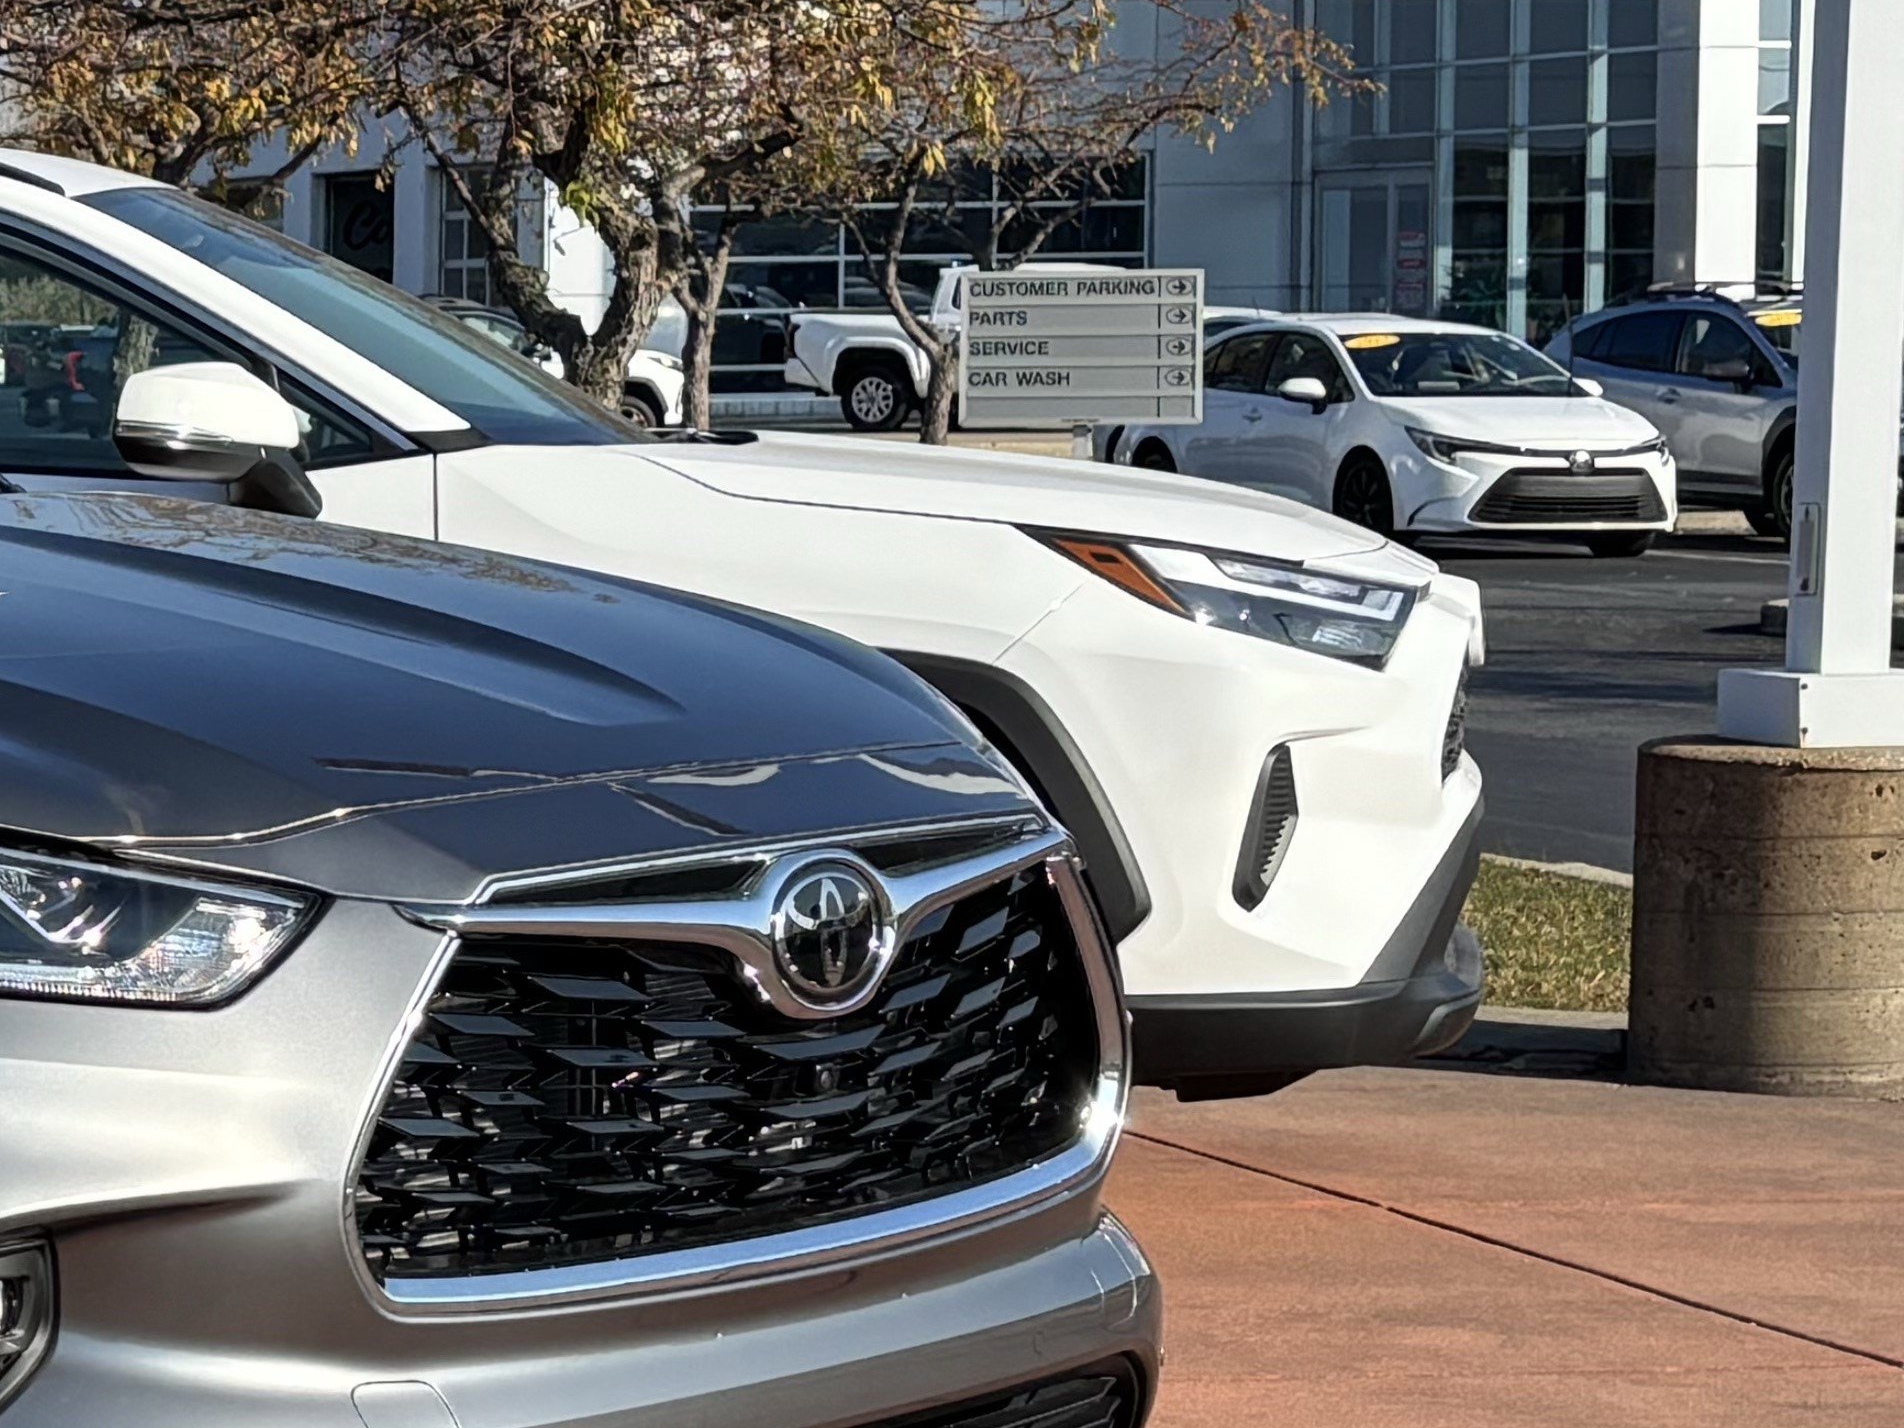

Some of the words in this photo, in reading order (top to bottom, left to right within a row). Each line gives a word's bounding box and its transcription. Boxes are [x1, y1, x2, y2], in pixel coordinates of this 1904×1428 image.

[969, 280, 1069, 298] CUSTOMER
[1076, 279, 1157, 296] PARKING
[969, 310, 1029, 326] PARTS
[969, 340, 1050, 357] SERVICE
[967, 371, 1008, 387] CAR
[1015, 371, 1071, 387] WASH
